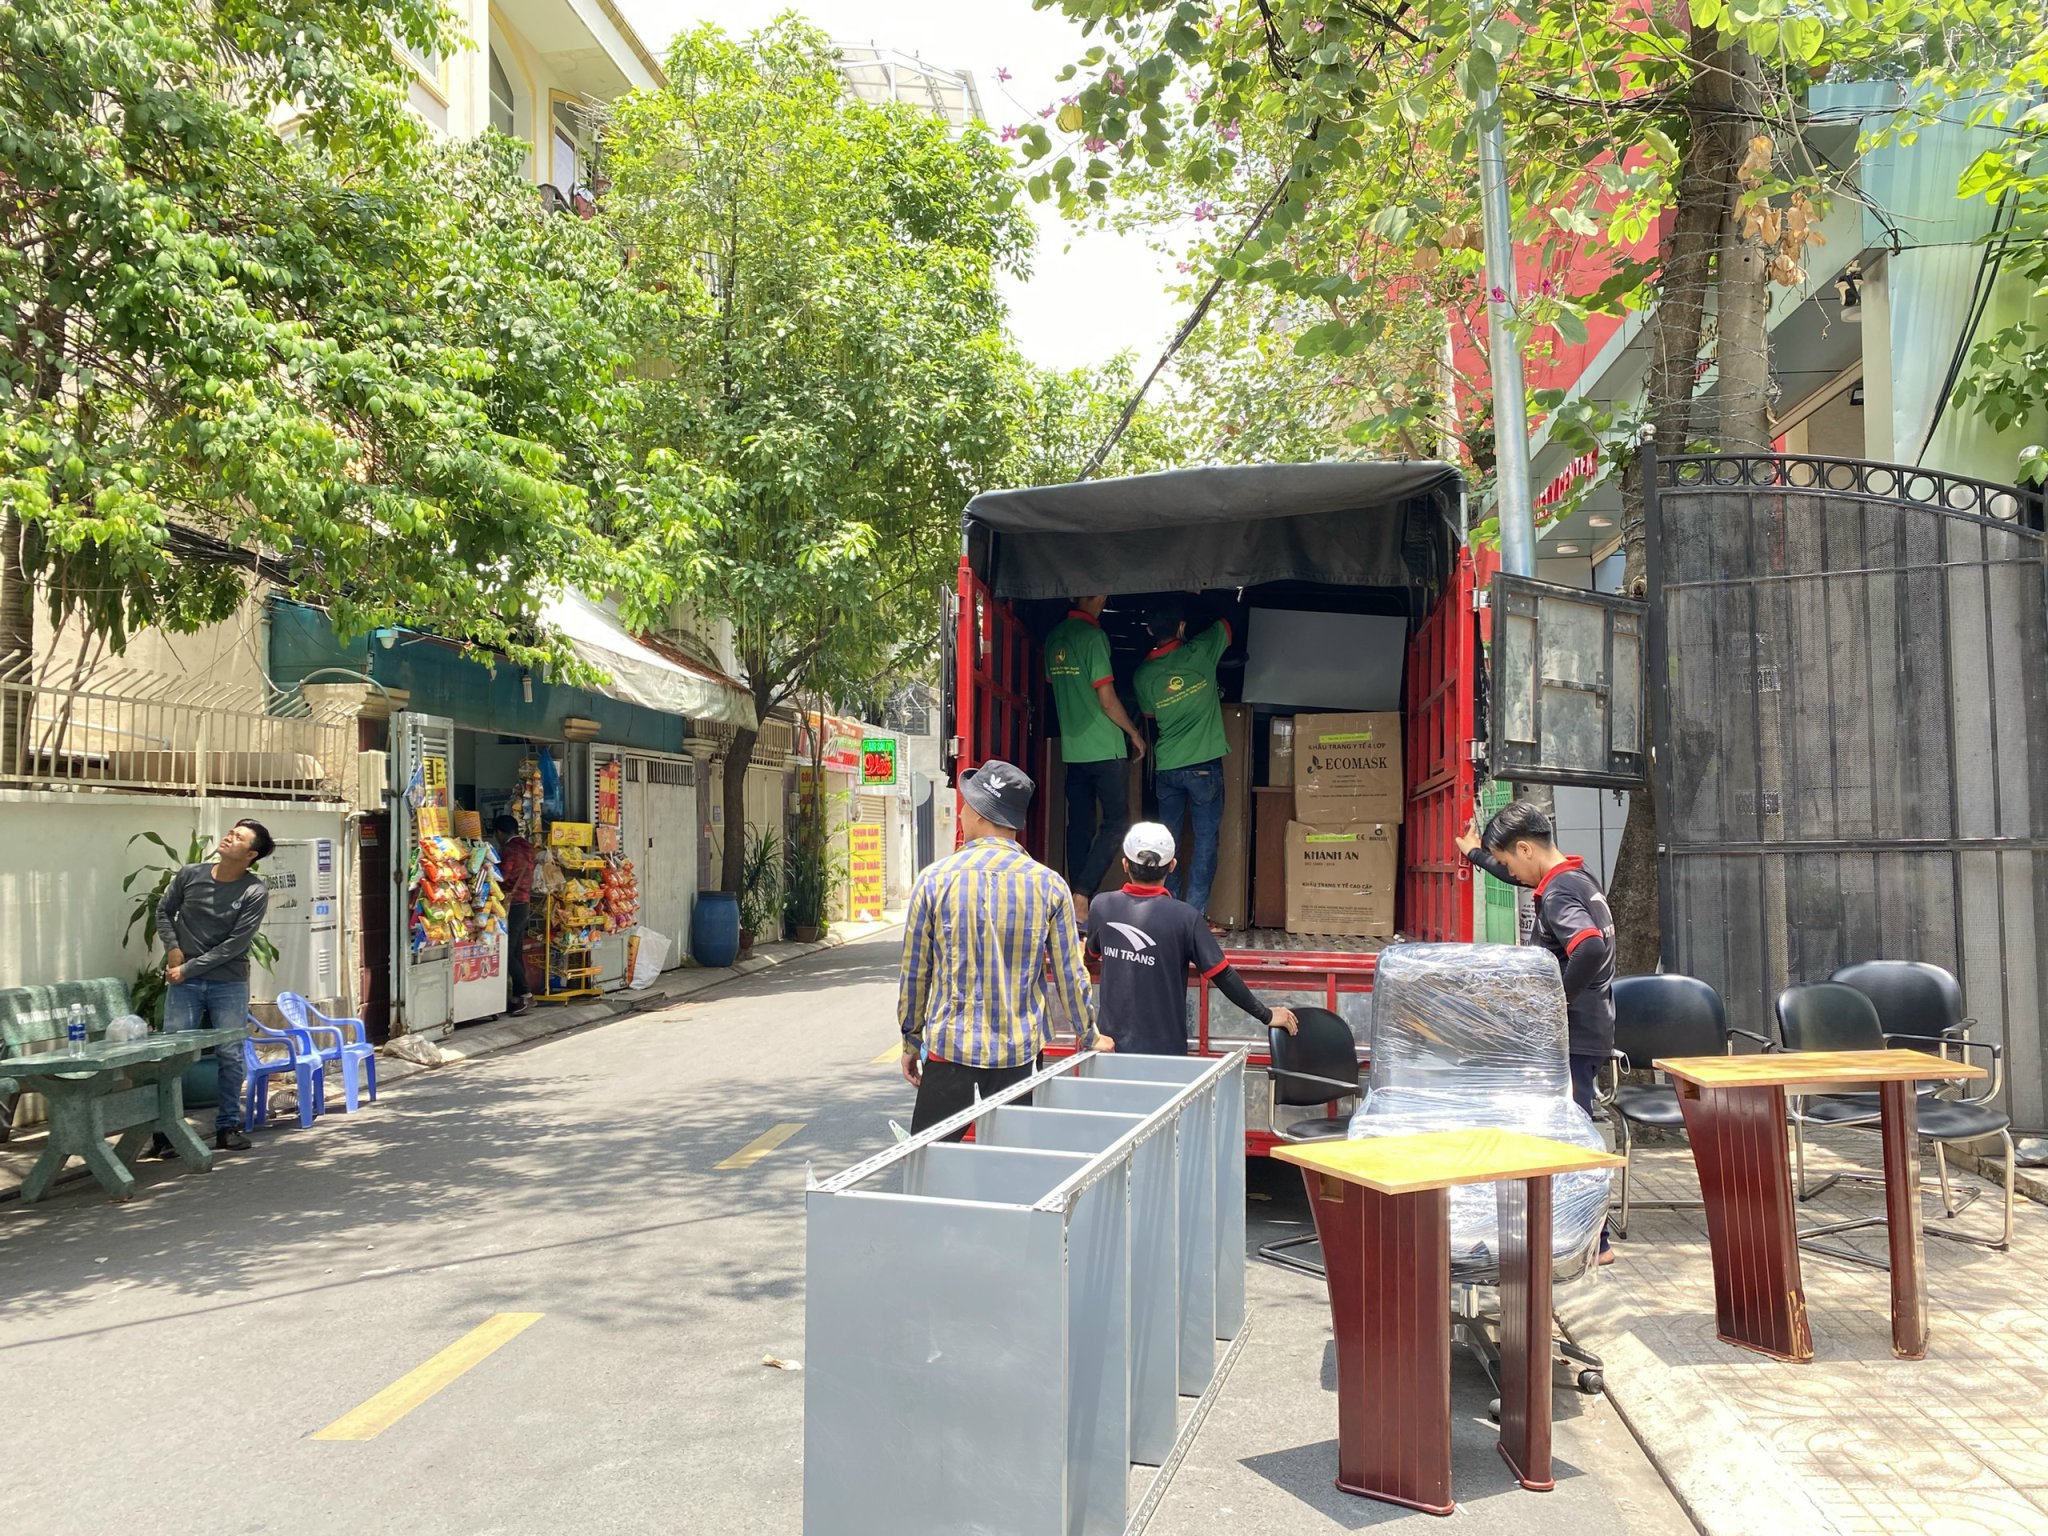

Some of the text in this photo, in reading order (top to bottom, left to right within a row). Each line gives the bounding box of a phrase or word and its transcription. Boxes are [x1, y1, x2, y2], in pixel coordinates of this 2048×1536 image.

[1325, 756, 1388, 770] ECOMASK
[982, 782, 1002, 798] adidas
[1344, 851, 1359, 860] AN
[1104, 946, 1156, 966] UNI TRANS
